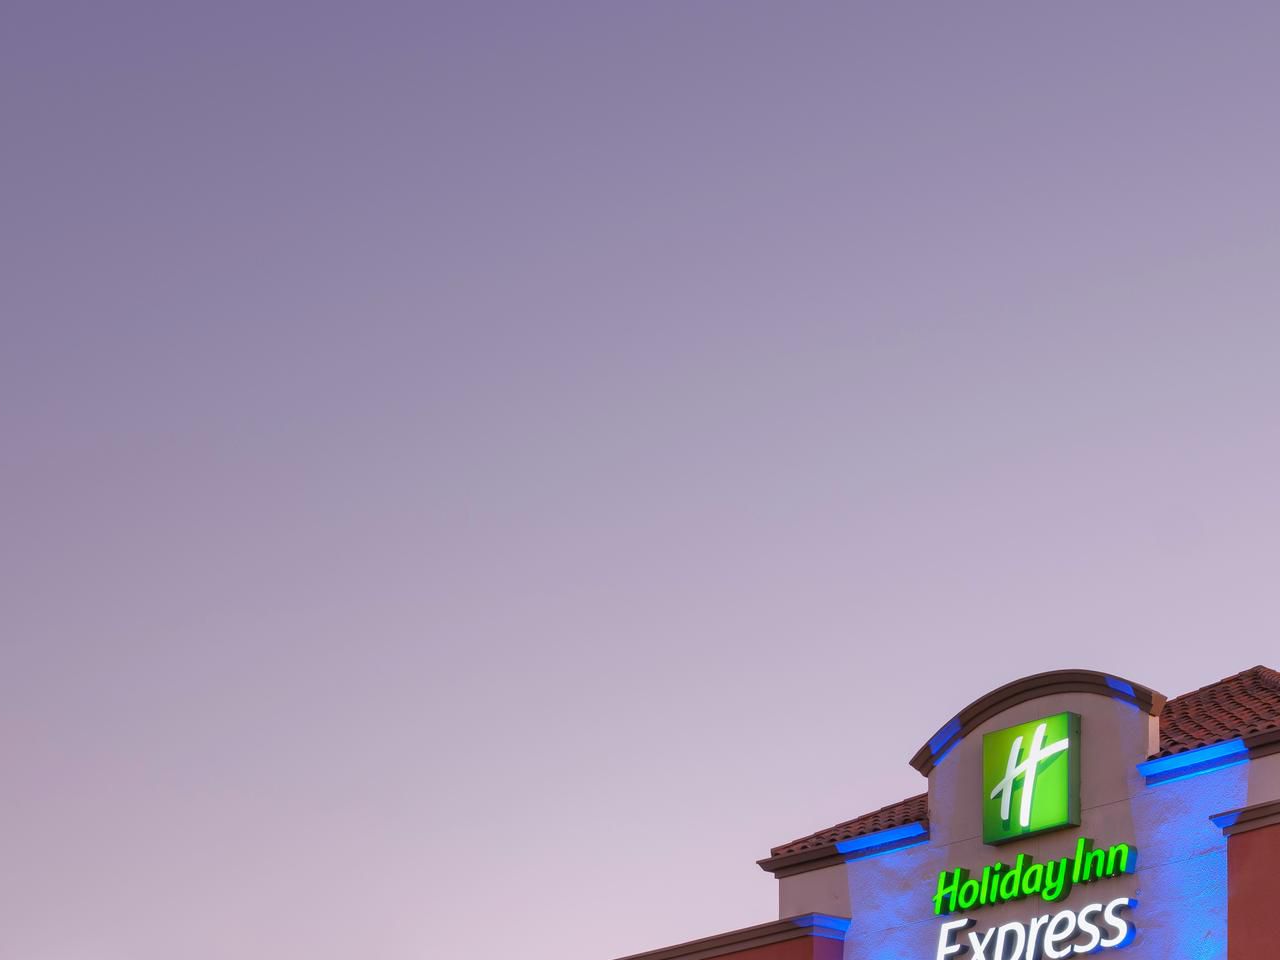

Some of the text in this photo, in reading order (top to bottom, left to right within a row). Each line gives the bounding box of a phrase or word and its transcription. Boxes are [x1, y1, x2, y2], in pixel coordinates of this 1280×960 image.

[990, 723, 1069, 827] H
[933, 837, 1130, 915] Holiday Inn
